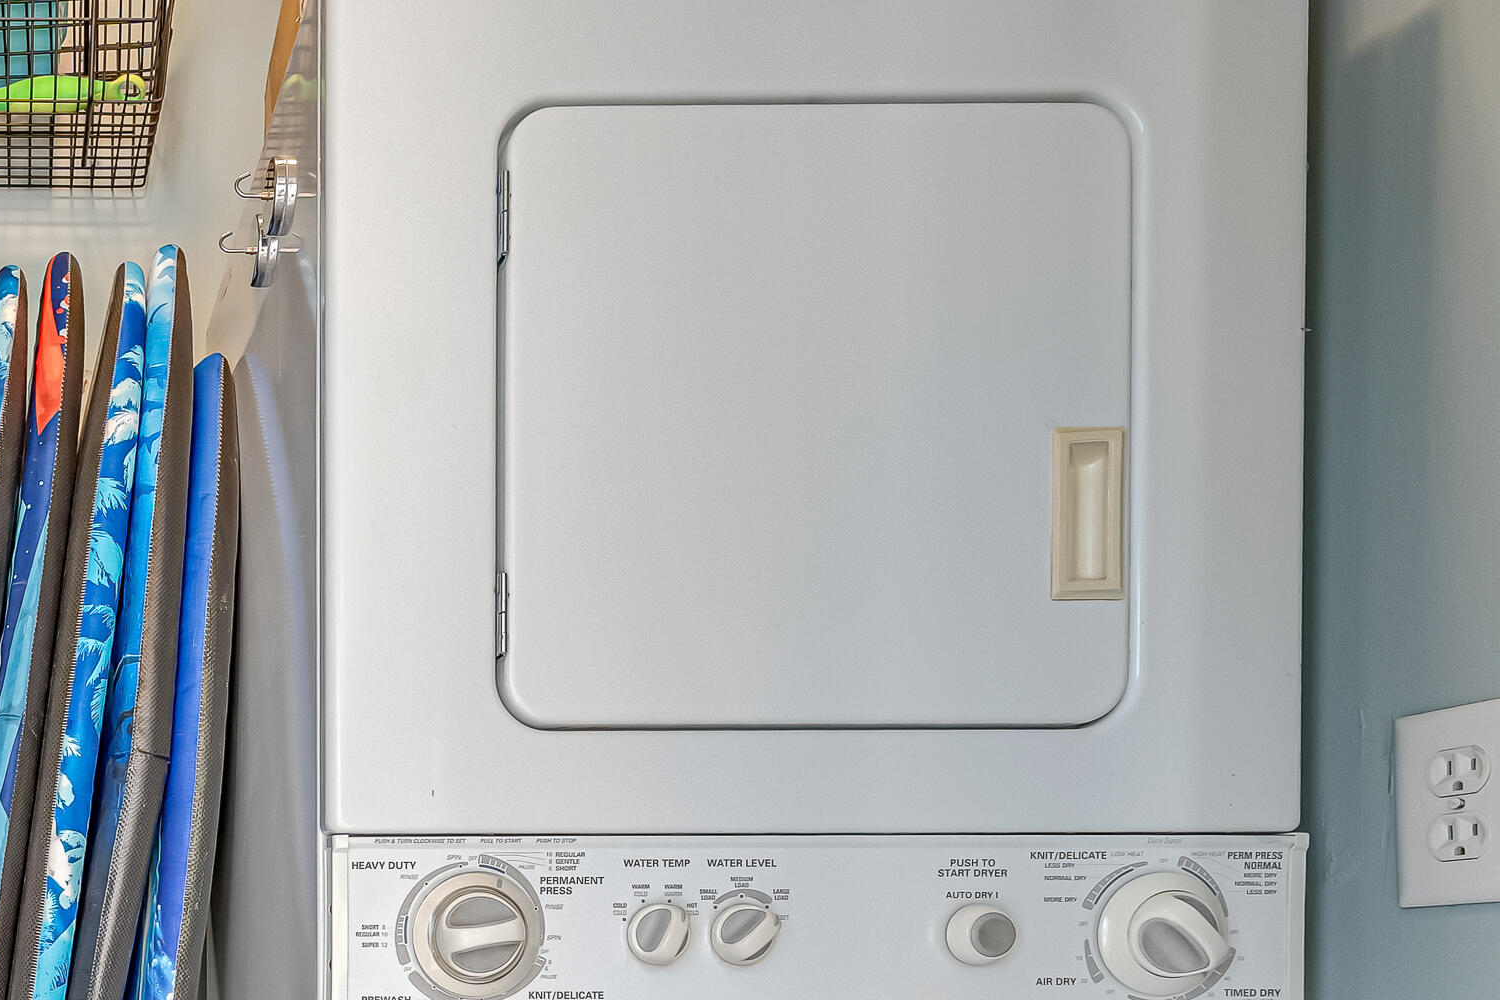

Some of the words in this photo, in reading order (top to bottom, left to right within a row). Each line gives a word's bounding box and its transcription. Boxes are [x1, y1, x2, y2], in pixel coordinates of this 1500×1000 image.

[1030, 851, 1107, 860] KNIT/DELICATE
[623, 859, 659, 867] WATER
[662, 859, 690, 867] TEMP
[707, 859, 743, 867] WATER
[745, 859, 777, 867] LEVEL
[950, 858, 978, 867] PUSH
[982, 858, 996, 867] TO
[1244, 862, 1282, 870] NORMAL
[938, 869, 971, 878] START
[974, 869, 1008, 878] DRYER
[540, 887, 572, 895] PRESS
[946, 891, 972, 899] AUTO
[975, 891, 993, 899] DRY
[1035, 978, 1053, 986] AIR
[1056, 978, 1076, 986] DRY
[528, 991, 604, 1000] KNIT/DELICATE
[1224, 989, 1256, 997] TIMED
[1260, 989, 1281, 997] DRY
